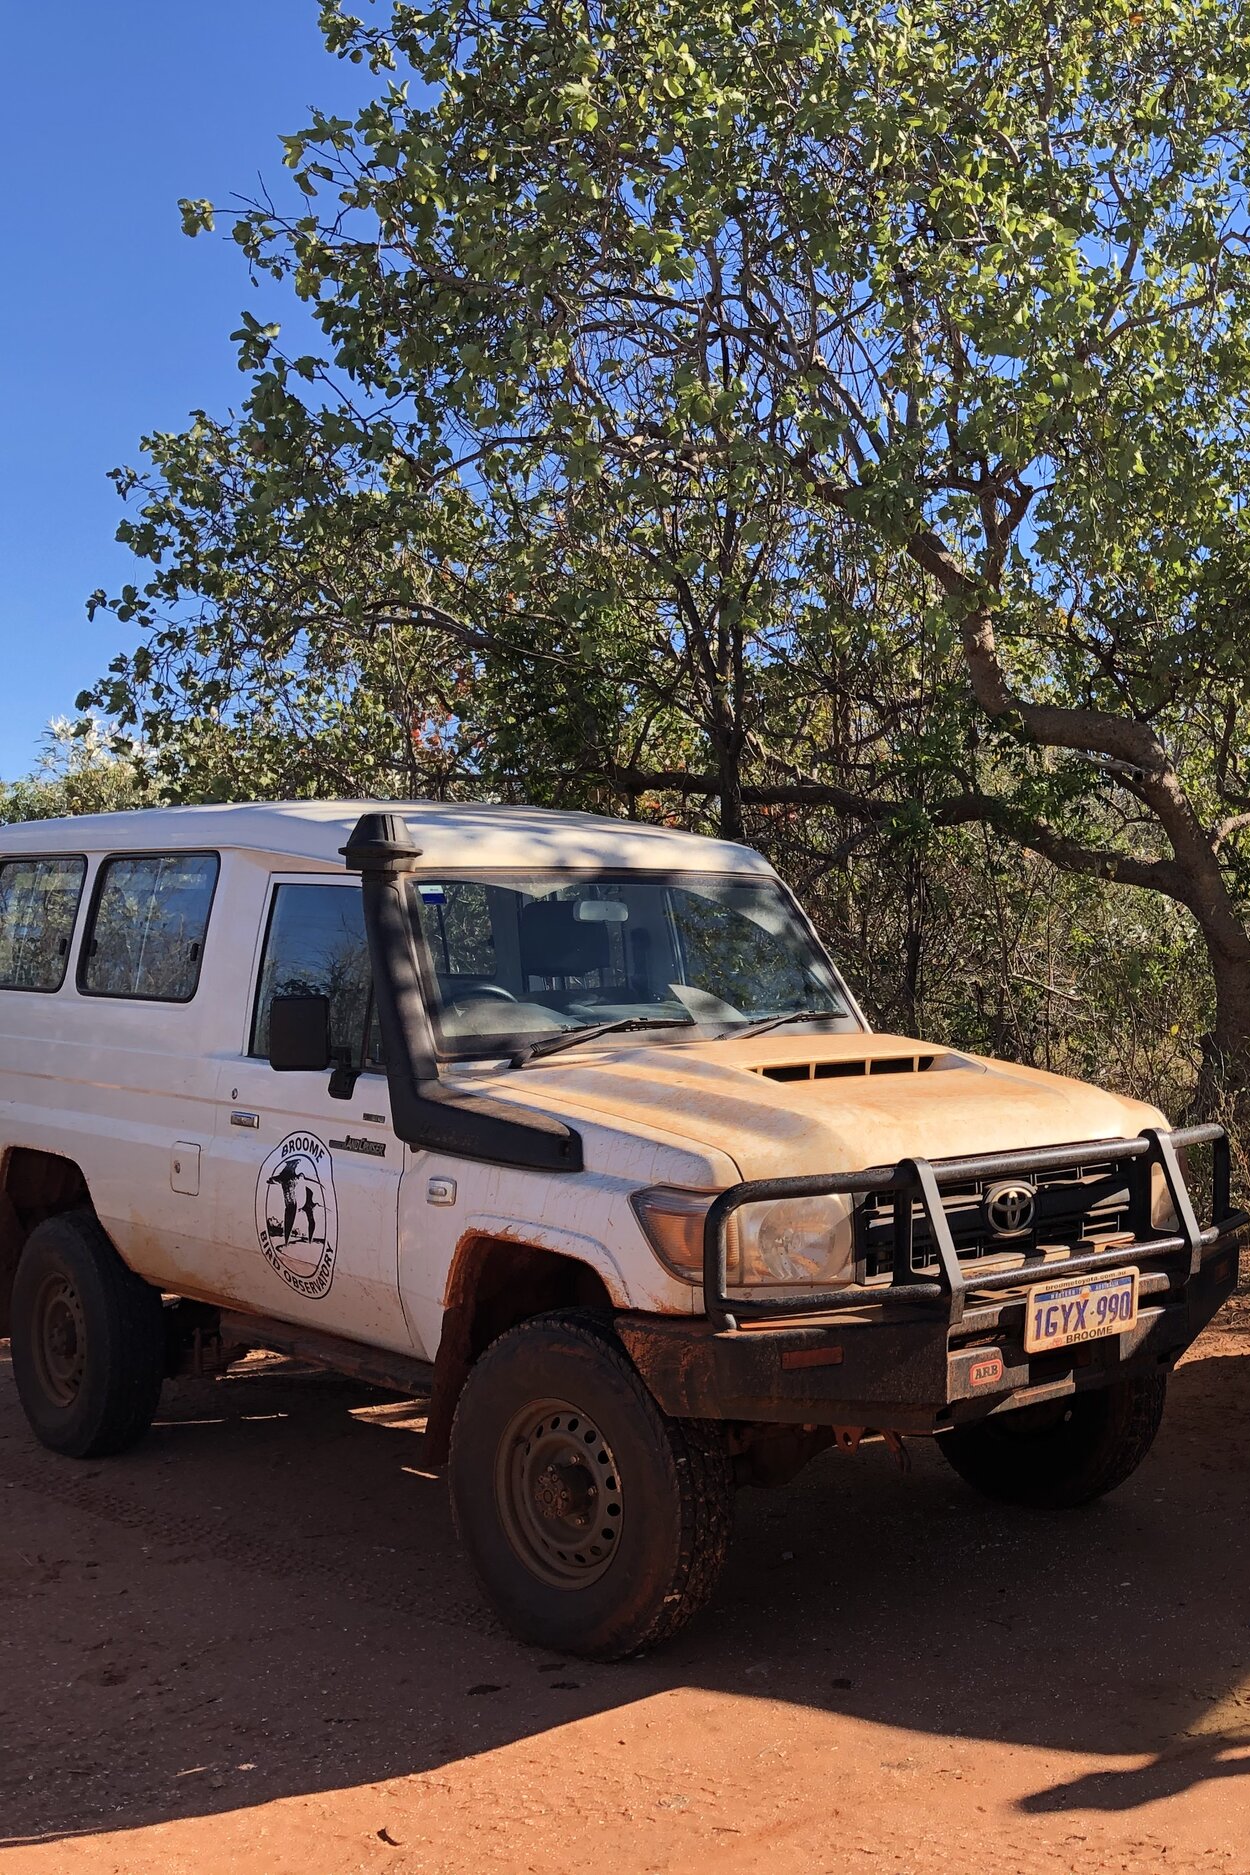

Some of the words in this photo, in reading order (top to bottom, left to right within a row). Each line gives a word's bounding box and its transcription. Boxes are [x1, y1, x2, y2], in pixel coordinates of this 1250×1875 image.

[281, 1137, 325, 1164] BROOME
[259, 1230, 281, 1271] BIRD
[283, 1241, 334, 1296] OBSERVATORY
[1045, 1270, 1127, 1291] broometoyota.com.au
[1066, 1325, 1114, 1344] BROOME
[975, 1364, 999, 1380] ARB
